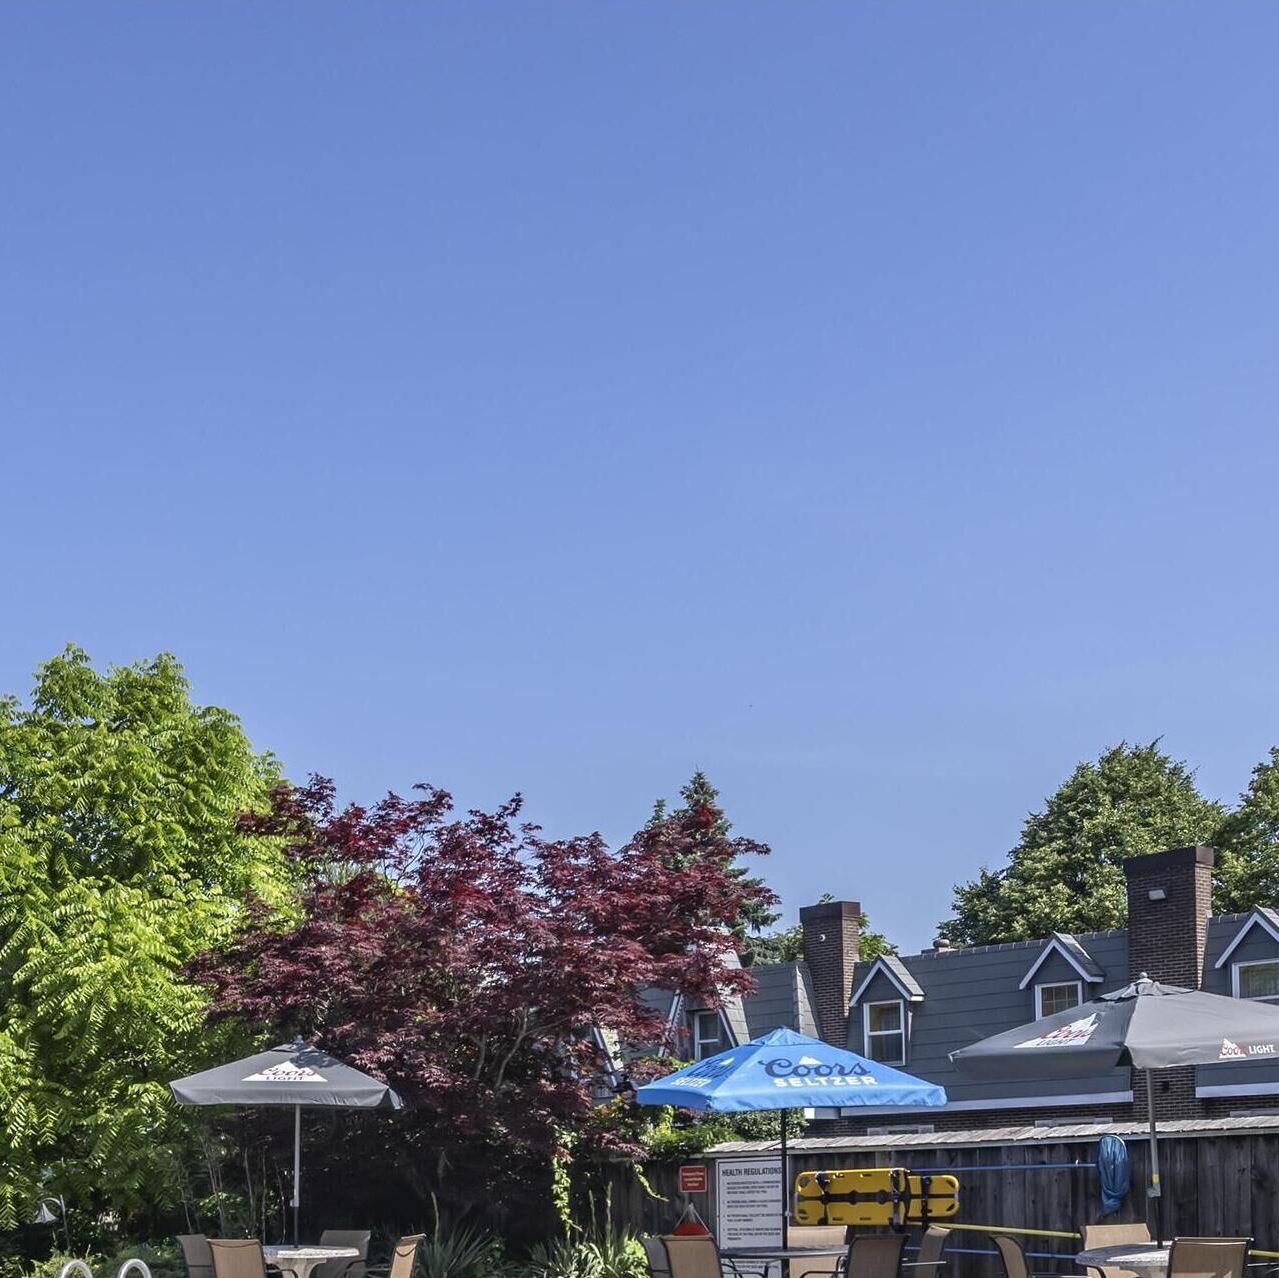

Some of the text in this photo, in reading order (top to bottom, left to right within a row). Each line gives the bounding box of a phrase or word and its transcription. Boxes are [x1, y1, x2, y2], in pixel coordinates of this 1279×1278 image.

[1248, 1044, 1275, 1055] LIGHT
[758, 1058, 871, 1078] Coors
[773, 1076, 878, 1087] SELTZER
[721, 1168, 743, 1177] HEALTH
